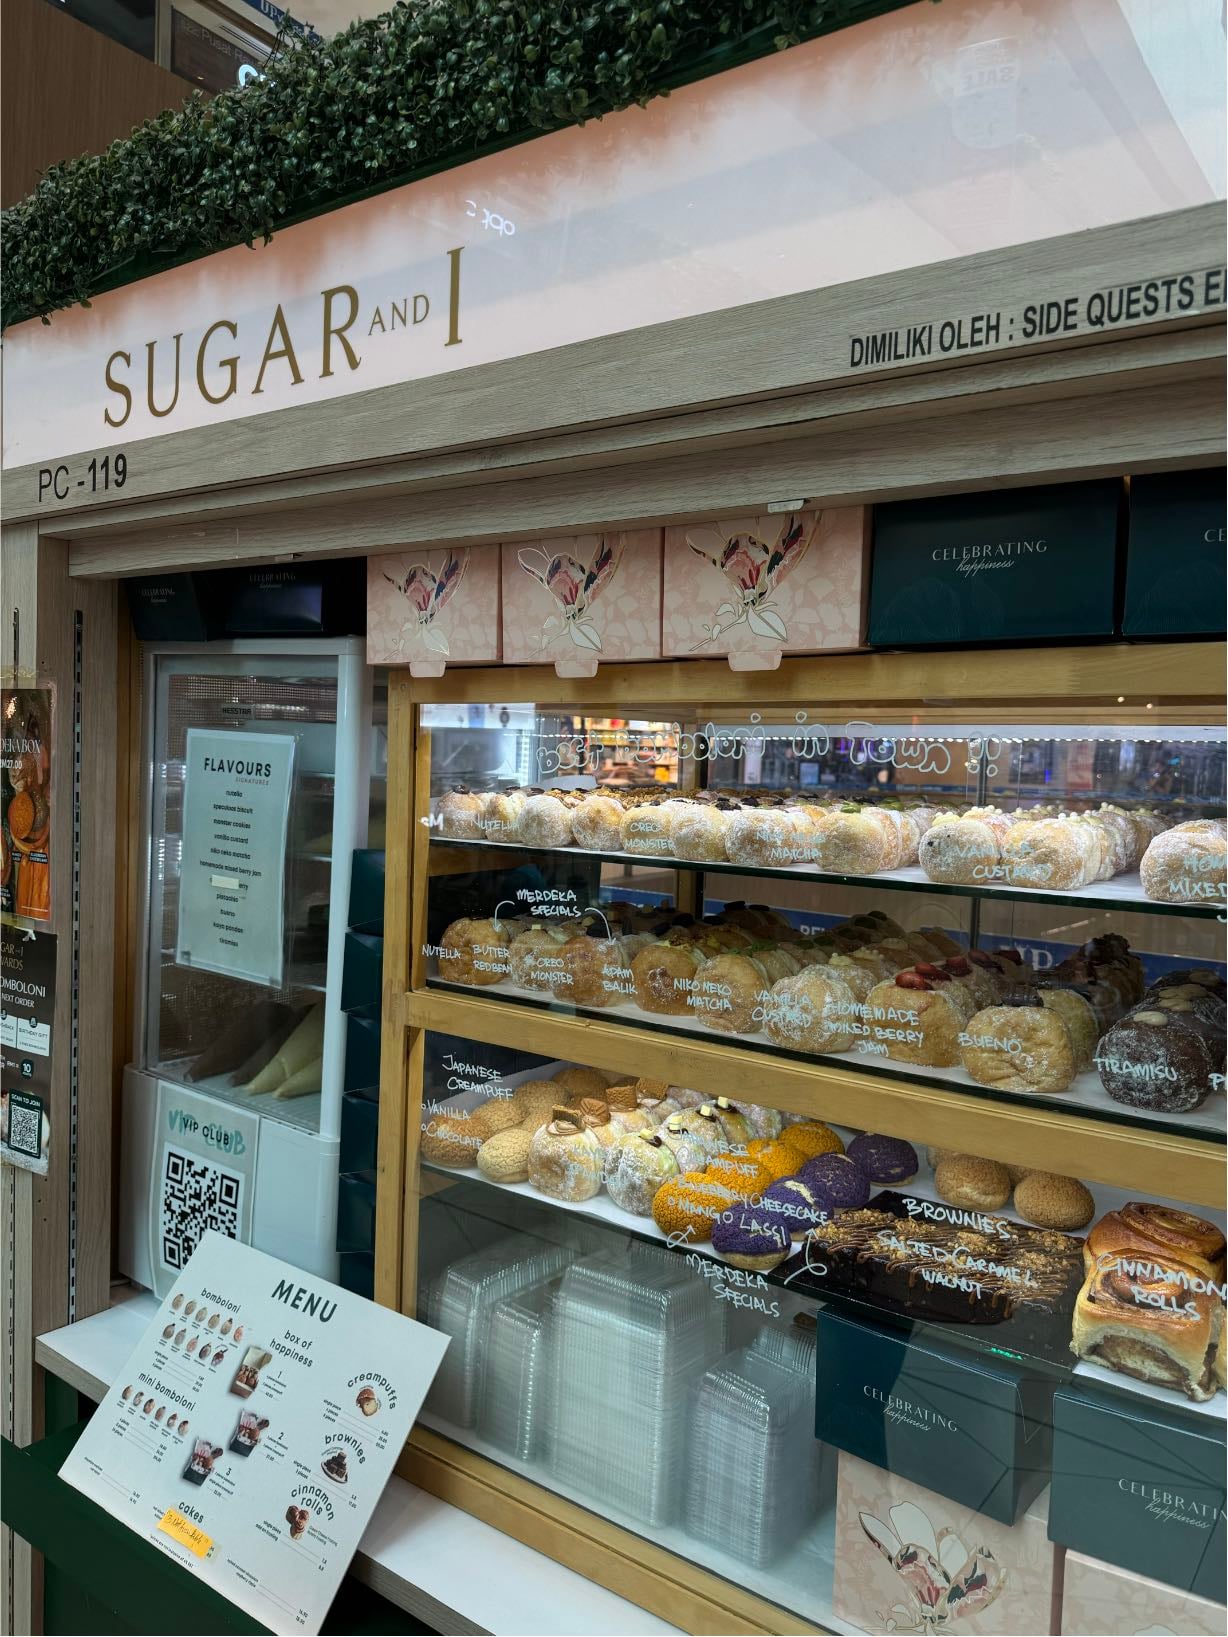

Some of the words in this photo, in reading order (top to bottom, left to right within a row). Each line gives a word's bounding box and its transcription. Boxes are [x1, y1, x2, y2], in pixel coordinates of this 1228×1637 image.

[850, 324, 932, 369] DIMILIKI
[939, 313, 1001, 353] OLEH
[1022, 299, 1079, 340] SIDE
[1086, 275, 1194, 331] QUESTS
[103, 285, 362, 429] SUGAR
[368, 293, 430, 337] AND
[444, 246, 465, 347] I
[39, 465, 70, 502] PC
[932, 540, 1047, 561] CELEBRATING
[955, 553, 1015, 578] happiness
[204, 757, 272, 778] FLAVOURS
[516, 888, 577, 902] MERDEKA
[530, 904, 582, 918] SPECIALS
[421, 943, 461, 959] NUTELLA
[472, 944, 512, 959] BUTTER
[535, 957, 565, 968] OREO
[530, 971, 574, 985] MONSTER
[602, 981, 638, 995] BALIK
[673, 978, 701, 992] NIKO
[702, 980, 732, 996] NEKO
[15, 996, 35, 1008] ORDER
[687, 996, 733, 1011] MATCHA
[857, 1040, 890, 1058] JAM
[876, 1027, 925, 1048] BERRY
[957, 1032, 1023, 1054] BUENO
[441, 1054, 504, 1084] JAPANESE
[1092, 1057, 1178, 1082] TIRAMISU
[446, 1076, 514, 1102] CREAMPUFF
[426, 1098, 471, 1121] VANILLA
[182, 1116, 199, 1133] VIP
[202, 1125, 229, 1146] CLUB
[425, 1122, 484, 1150] CHOCOLATE
[678, 1196, 734, 1224] MANGO
[739, 1212, 787, 1245] LASSI
[750, 1192, 829, 1226] CHEESECAKE
[901, 1198, 1012, 1240] BROWNIES
[876, 1229, 950, 1263] SALTED
[952, 1246, 1033, 1283] CARAMEL
[686, 1252, 769, 1291] MERDEKA
[920, 1268, 984, 1300] WALNUT
[1096, 1253, 1228, 1301] CINNAMON
[200, 1288, 241, 1313] bomboloni
[271, 1279, 338, 1323] MENU
[712, 1283, 781, 1317] SPECIALS
[1130, 1285, 1202, 1321] ROLLS
[284, 1330, 305, 1350] box
[301, 1340, 312, 1355] of
[270, 1342, 314, 1371] happiness
[137, 1372, 155, 1386] mini
[153, 1381, 196, 1411] bomboloni
[347, 1372, 396, 1411] creampuffs
[863, 1385, 958, 1432] CELEBRATING
[883, 1402, 931, 1431] happiness
[277, 1431, 285, 1442] 2
[325, 1432, 366, 1465] brownies
[225, 1467, 232, 1476] 3
[176, 1500, 206, 1523] cakes
[291, 1485, 334, 1521] cinnamon
[300, 1495, 324, 1516] rolls
[1144, 1496, 1211, 1529] happiness
